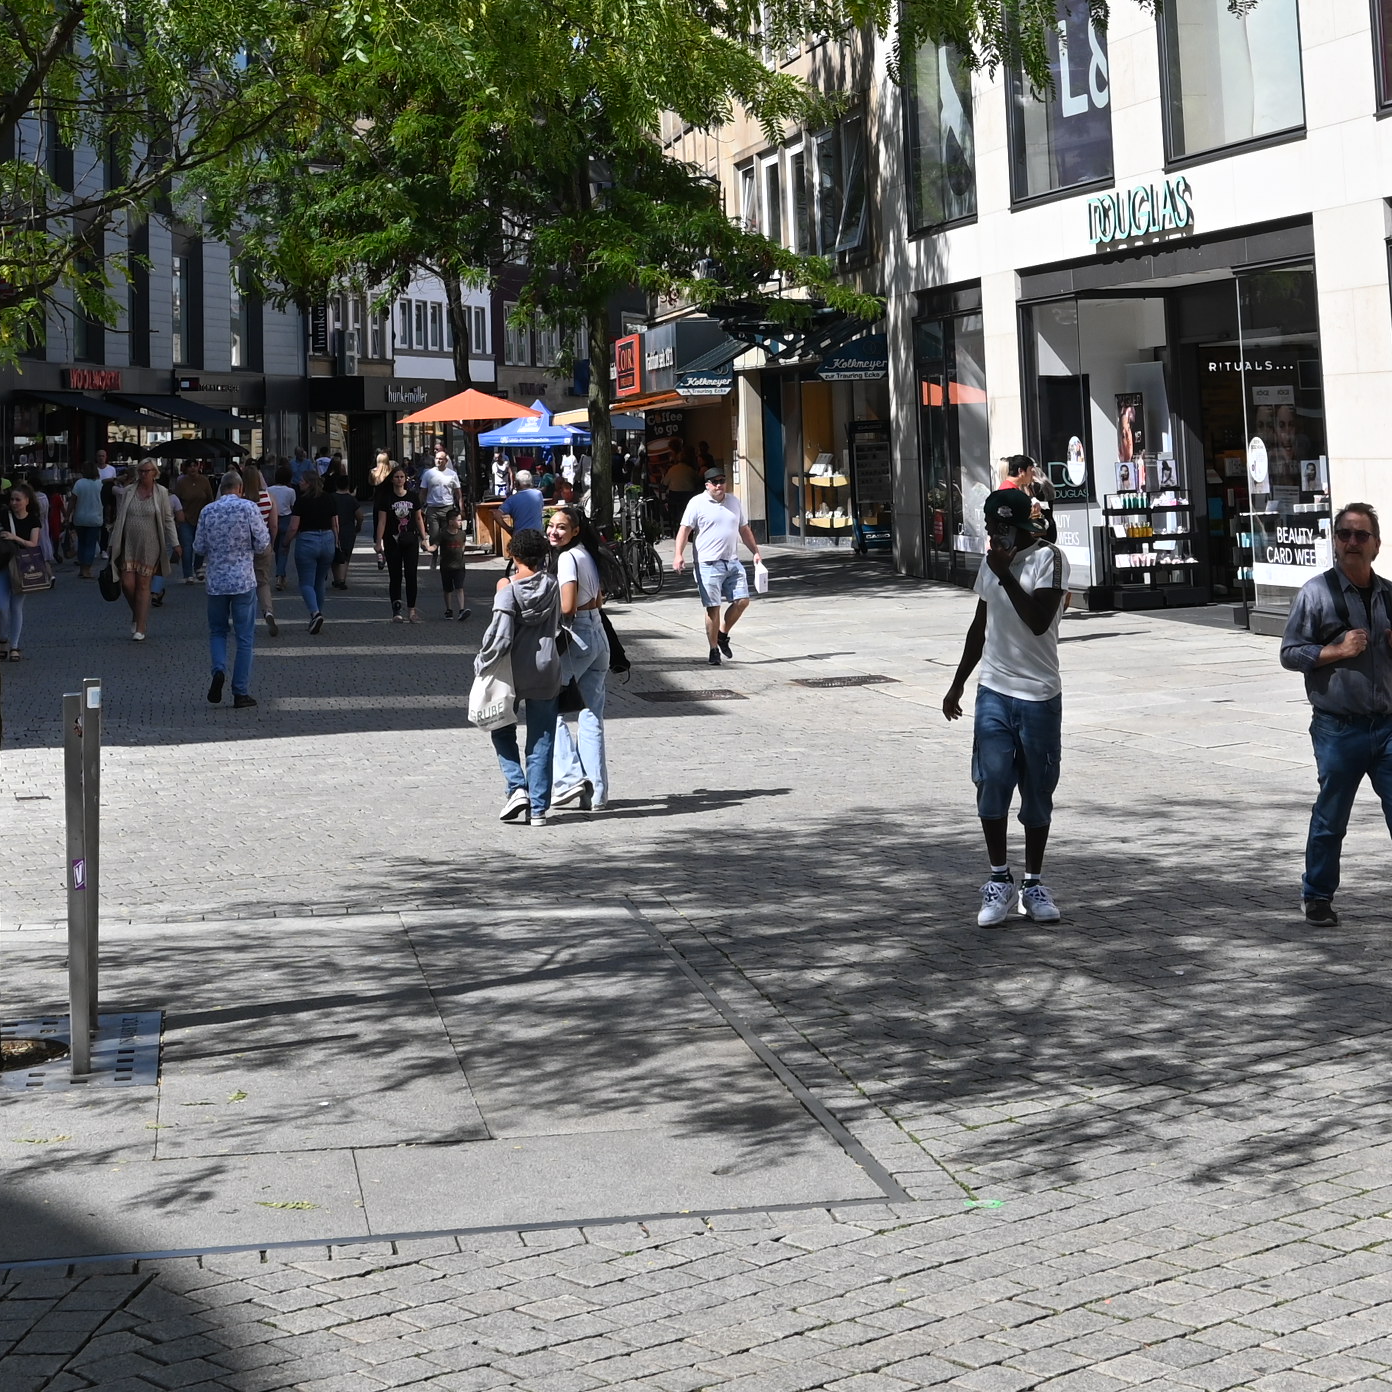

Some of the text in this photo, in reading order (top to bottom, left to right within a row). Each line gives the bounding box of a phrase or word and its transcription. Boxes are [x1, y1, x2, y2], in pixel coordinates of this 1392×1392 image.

[1087, 176, 1189, 245] DOUGLAS
[824, 357, 888, 371] Kolkmeyer
[680, 377, 733, 388] Kolkmeyer
[387, 384, 428, 404] hunkemöller
[654, 424, 679, 437] to go
[1054, 489, 1089, 499] OUGLAS
[1276, 526, 1314, 545] BEAUTY
[1266, 546, 1318, 566] CARD WEE
